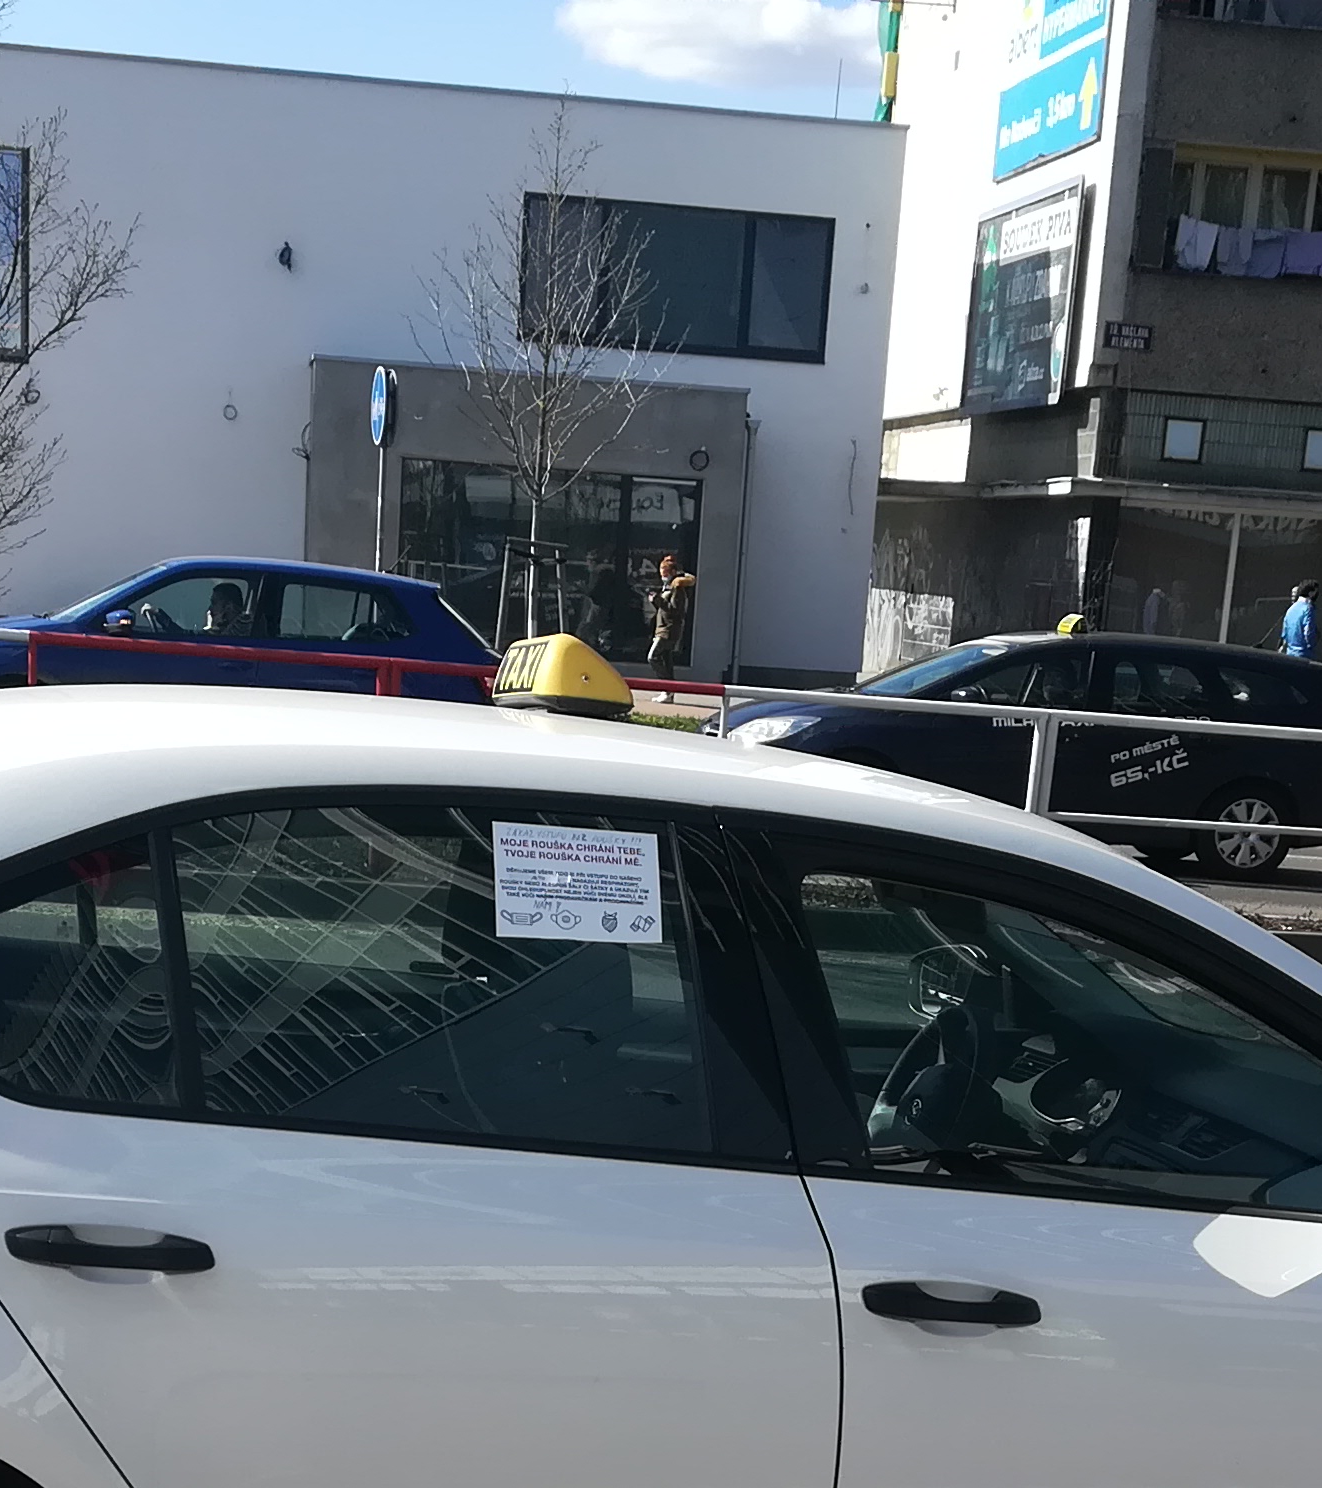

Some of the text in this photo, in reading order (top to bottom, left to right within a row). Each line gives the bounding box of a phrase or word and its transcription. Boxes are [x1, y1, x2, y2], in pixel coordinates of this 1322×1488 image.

[1046, 209, 1072, 241] PIVA
[499, 644, 546, 691] TAXI
[992, 717, 1035, 727] MILA
[1110, 734, 1180, 763] PO MĚSTĚ
[500, 838, 645, 857] MOJE ROUŠKA CHRÁNÍ TEBE.
[504, 849, 536, 859] TVOJE
[539, 851, 581, 862] ROUŠKA
[584, 854, 622, 865] CHRÁNÍ
